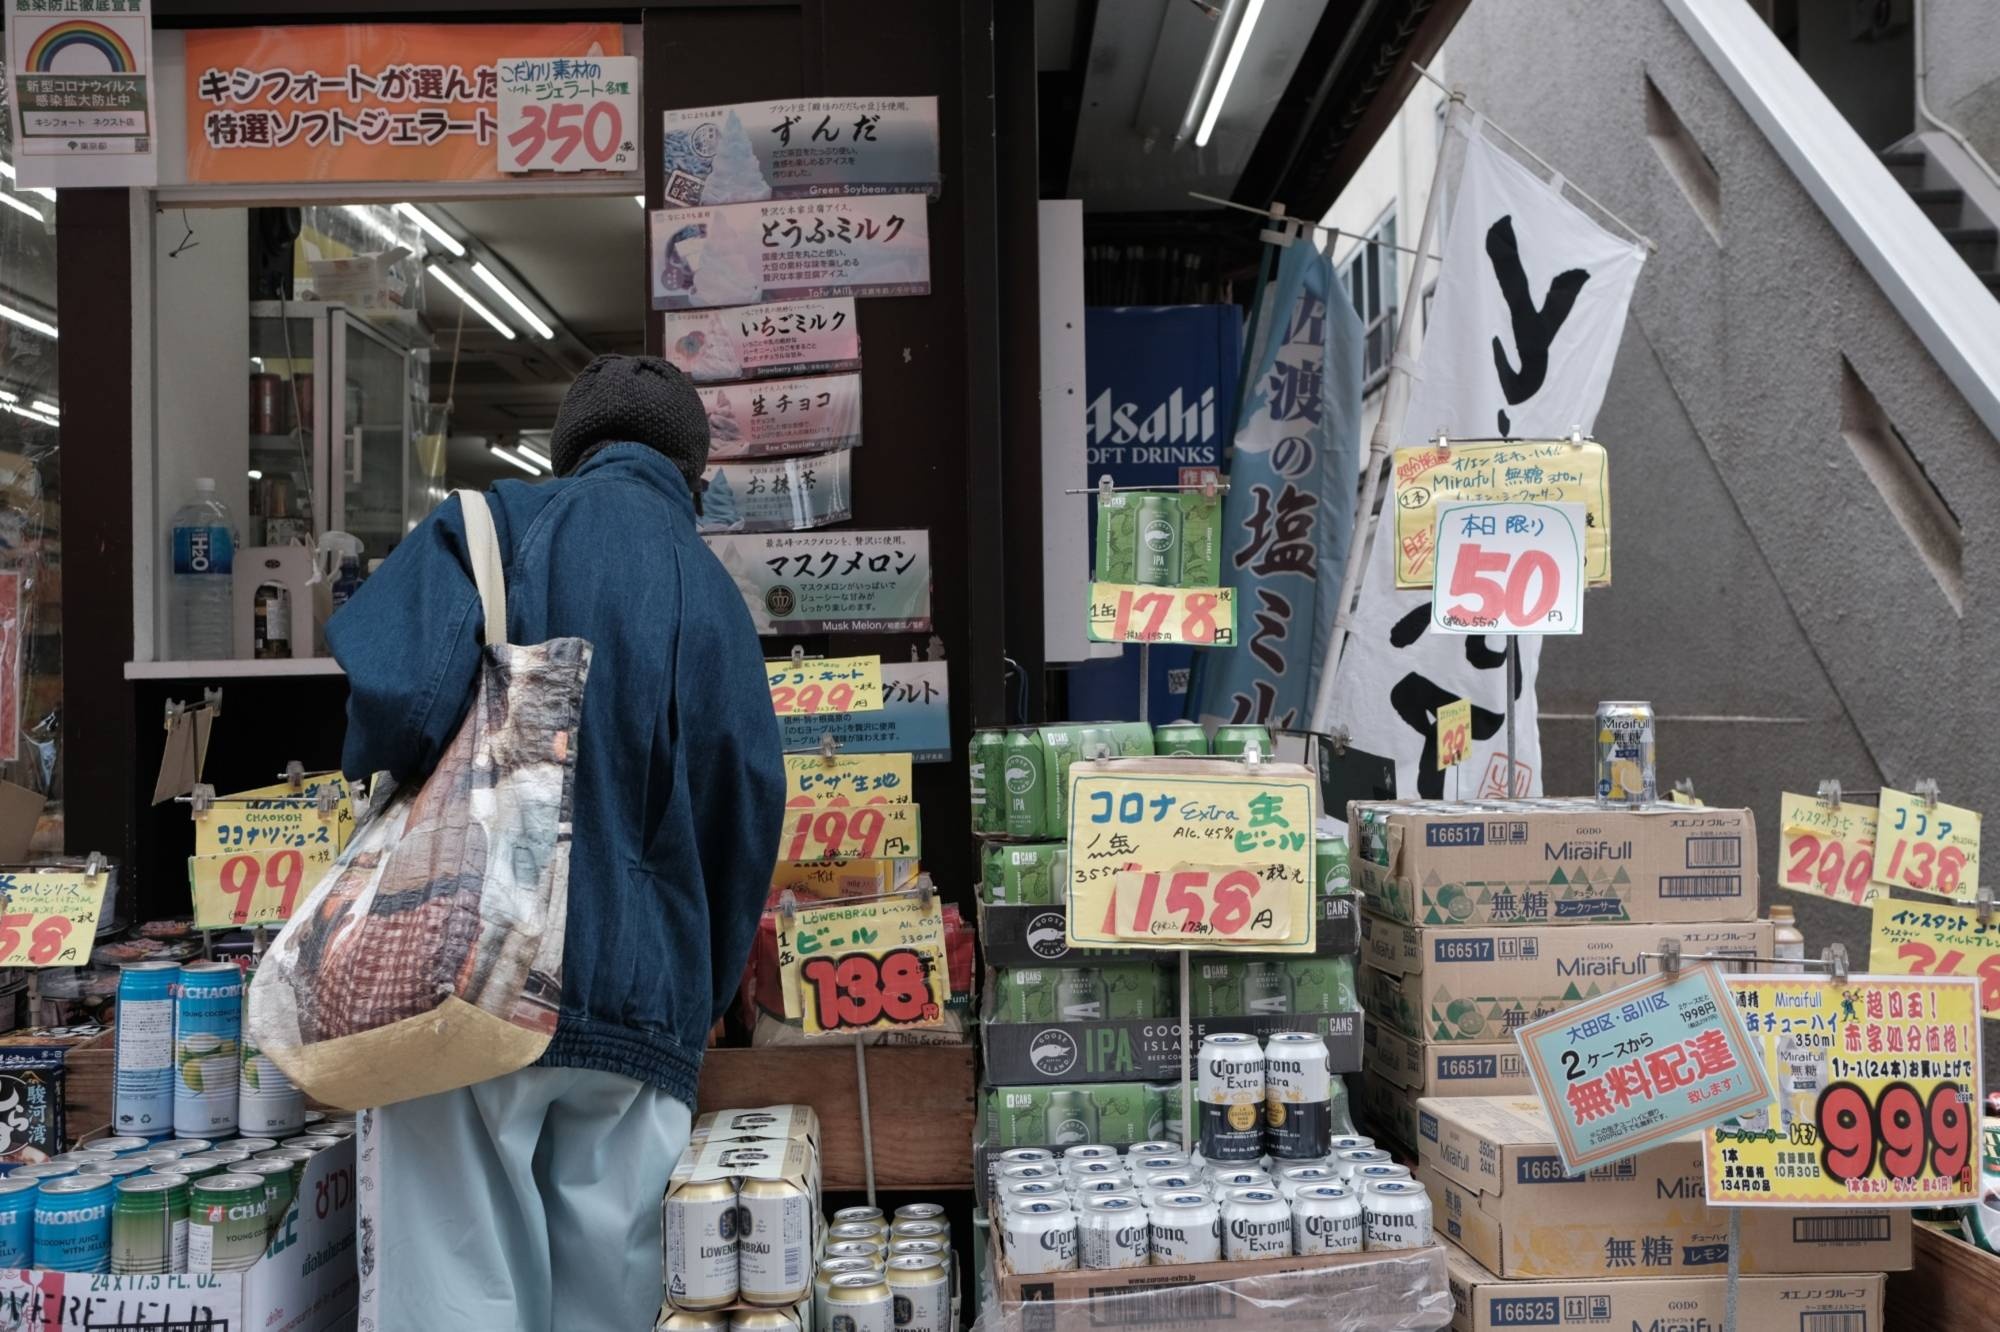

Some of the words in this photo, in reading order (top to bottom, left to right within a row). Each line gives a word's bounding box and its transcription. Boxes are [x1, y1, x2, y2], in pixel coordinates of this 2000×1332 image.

[27, 79, 137, 94] 新型コロナウイルス
[35, 94, 131, 107] 感染拡大防止中
[34, 117, 85, 127] キシフォート
[770, 113, 881, 148] ずんだ
[508, 100, 623, 167] 350
[616, 153, 627, 163] 円
[808, 184, 843, 196] Green
[844, 183, 888, 196] Soybean
[761, 213, 906, 249] とうふミルク
[807, 287, 830, 298] Tofu
[741, 310, 847, 338] いちごミルク
[756, 364, 792, 376] Strawberry
[792, 363, 808, 374] Milk
[751, 391, 832, 418] 生チョコ
[1086, 386, 1215, 445] Asahi
[782, 441, 816, 452] Chocolate
[1131, 445, 1216, 465] DRINKS
[746, 468, 818, 496] お抹茶
[1504, 465, 1545, 488] 無糖
[1460, 513, 1545, 538] 本日限り
[766, 550, 917, 579] マスクメロン
[1152, 554, 1165, 567] IPA
[800, 580, 897, 593] マスクメロンがいっぱいで
[1446, 542, 1562, 628] 50
[800, 591, 876, 603] ジューシーな甘みが
[1089, 602, 1117, 619] 1缶
[1113, 589, 1220, 644] 178
[1547, 610, 1564, 622] 円
[822, 620, 850, 632] Musk
[851, 620, 882, 632] Melon
[1213, 627, 1233, 645] 円
[771, 684, 855, 715] 299
[1602, 719, 1650, 730] Miraifull
[799, 772, 901, 793] ピザ生地
[1012, 799, 1026, 812] IPA
[1090, 790, 1178, 825] コロナ
[1179, 800, 1241, 823] Extra
[1247, 791, 1291, 829] 缶
[245, 812, 303, 823] CHAOKOH
[1669, 818, 1743, 828] オエノングループ
[1894, 807, 1954, 841] ココア
[217, 824, 331, 847] ココナツジュース
[788, 808, 886, 861] 199
[1172, 826, 1202, 840] Alc.
[1429, 827, 1481, 844] 166517
[1513, 823, 1524, 832] 18
[1575, 827, 1602, 836] GODO
[883, 836, 905, 856] 円
[1233, 829, 1307, 854] ビール
[1544, 840, 1633, 861] Miraifull
[1020, 851, 1038, 864] CANS
[1886, 837, 1968, 895] 138
[1786, 834, 1874, 907] 299
[219, 849, 305, 925] 99
[1131, 869, 1262, 936] 158
[1326, 900, 1350, 916] CANS
[1490, 890, 1550, 922] 無糖
[802, 906, 878, 926] LÖWENBRÄU
[1250, 907, 1274, 931] 円
[1891, 909, 1970, 932] インスタント
[796, 926, 879, 955] ビール
[900, 930, 939, 945] 330ml
[1586, 942, 1614, 951] GODO
[1682, 932, 1757, 943] オエノングループ
[58, 947, 77, 961] 円
[1438, 941, 1491, 959] 166517
[1211, 964, 1228, 977] CANS
[1555, 954, 1648, 978] Miraifull
[801, 948, 935, 1032] 138
[1775, 990, 1823, 1009] Miraifull
[921, 1002, 940, 1021] 円
[1679, 1000, 1718, 1024] 1998円
[1866, 989, 1938, 1020] 超目玉!
[1329, 1017, 1353, 1034] CANS
[1566, 991, 1670, 1045] 大田区・品川区
[1745, 1011, 1838, 1034] 缶チューハイ
[1038, 1032, 1069, 1044] GOOSE
[1795, 1033, 1837, 1047] 350ml
[1844, 1022, 1970, 1053] 赤字処分価格!
[1085, 1027, 1135, 1074] IPA
[1780, 1051, 1826, 1062] Miraifull
[1037, 1058, 1072, 1074] ISLAND
[1441, 1058, 1493, 1077] 166517
[1790, 1065, 1818, 1077] 無糖
[1832, 1056, 1973, 1079] 1ケース(24本)お買い上げで
[1226, 1075, 1259, 1090] Extra
[1565, 1027, 1738, 1128] 無料配達
[1014, 1093, 1033, 1106] CANS
[27, 1084, 47, 1145] 駿河湾
[1789, 1122, 1818, 1146] レモン
[1816, 1080, 1972, 1185] 999
[1440, 1142, 1471, 1174] Miraifull
[1478, 1140, 1497, 1160] 350ml
[1721, 1147, 1739, 1164] 1本
[1777, 1151, 1817, 1165] 賞味期限
[1725, 1165, 1766, 1179] 通常価格
[1774, 1165, 1822, 1178] 10月30日
[1959, 1162, 1974, 1193] 円
[1721, 1179, 1772, 1192] 134円の品
[1844, 1177, 1889, 1194] 1本あたり
[1892, 1177, 1919, 1194] なんと
[1444, 1186, 1463, 1218] 無糖
[77, 1233, 101, 1245] JUICE
[226, 1231, 254, 1243] YOUNG
[1324, 1233, 1359, 1249] Extra
[1367, 1225, 1402, 1243] Extra
[1249, 1237, 1285, 1252] Extra
[1604, 1235, 1674, 1268] 無糖
[1691, 1248, 1728, 1262] レモン
[91, 1274, 110, 1292] 24
[1779, 1288, 1866, 1300] オエノングループ
[1494, 1302, 1555, 1321] 166525
[1668, 1300, 1699, 1311] GODO
